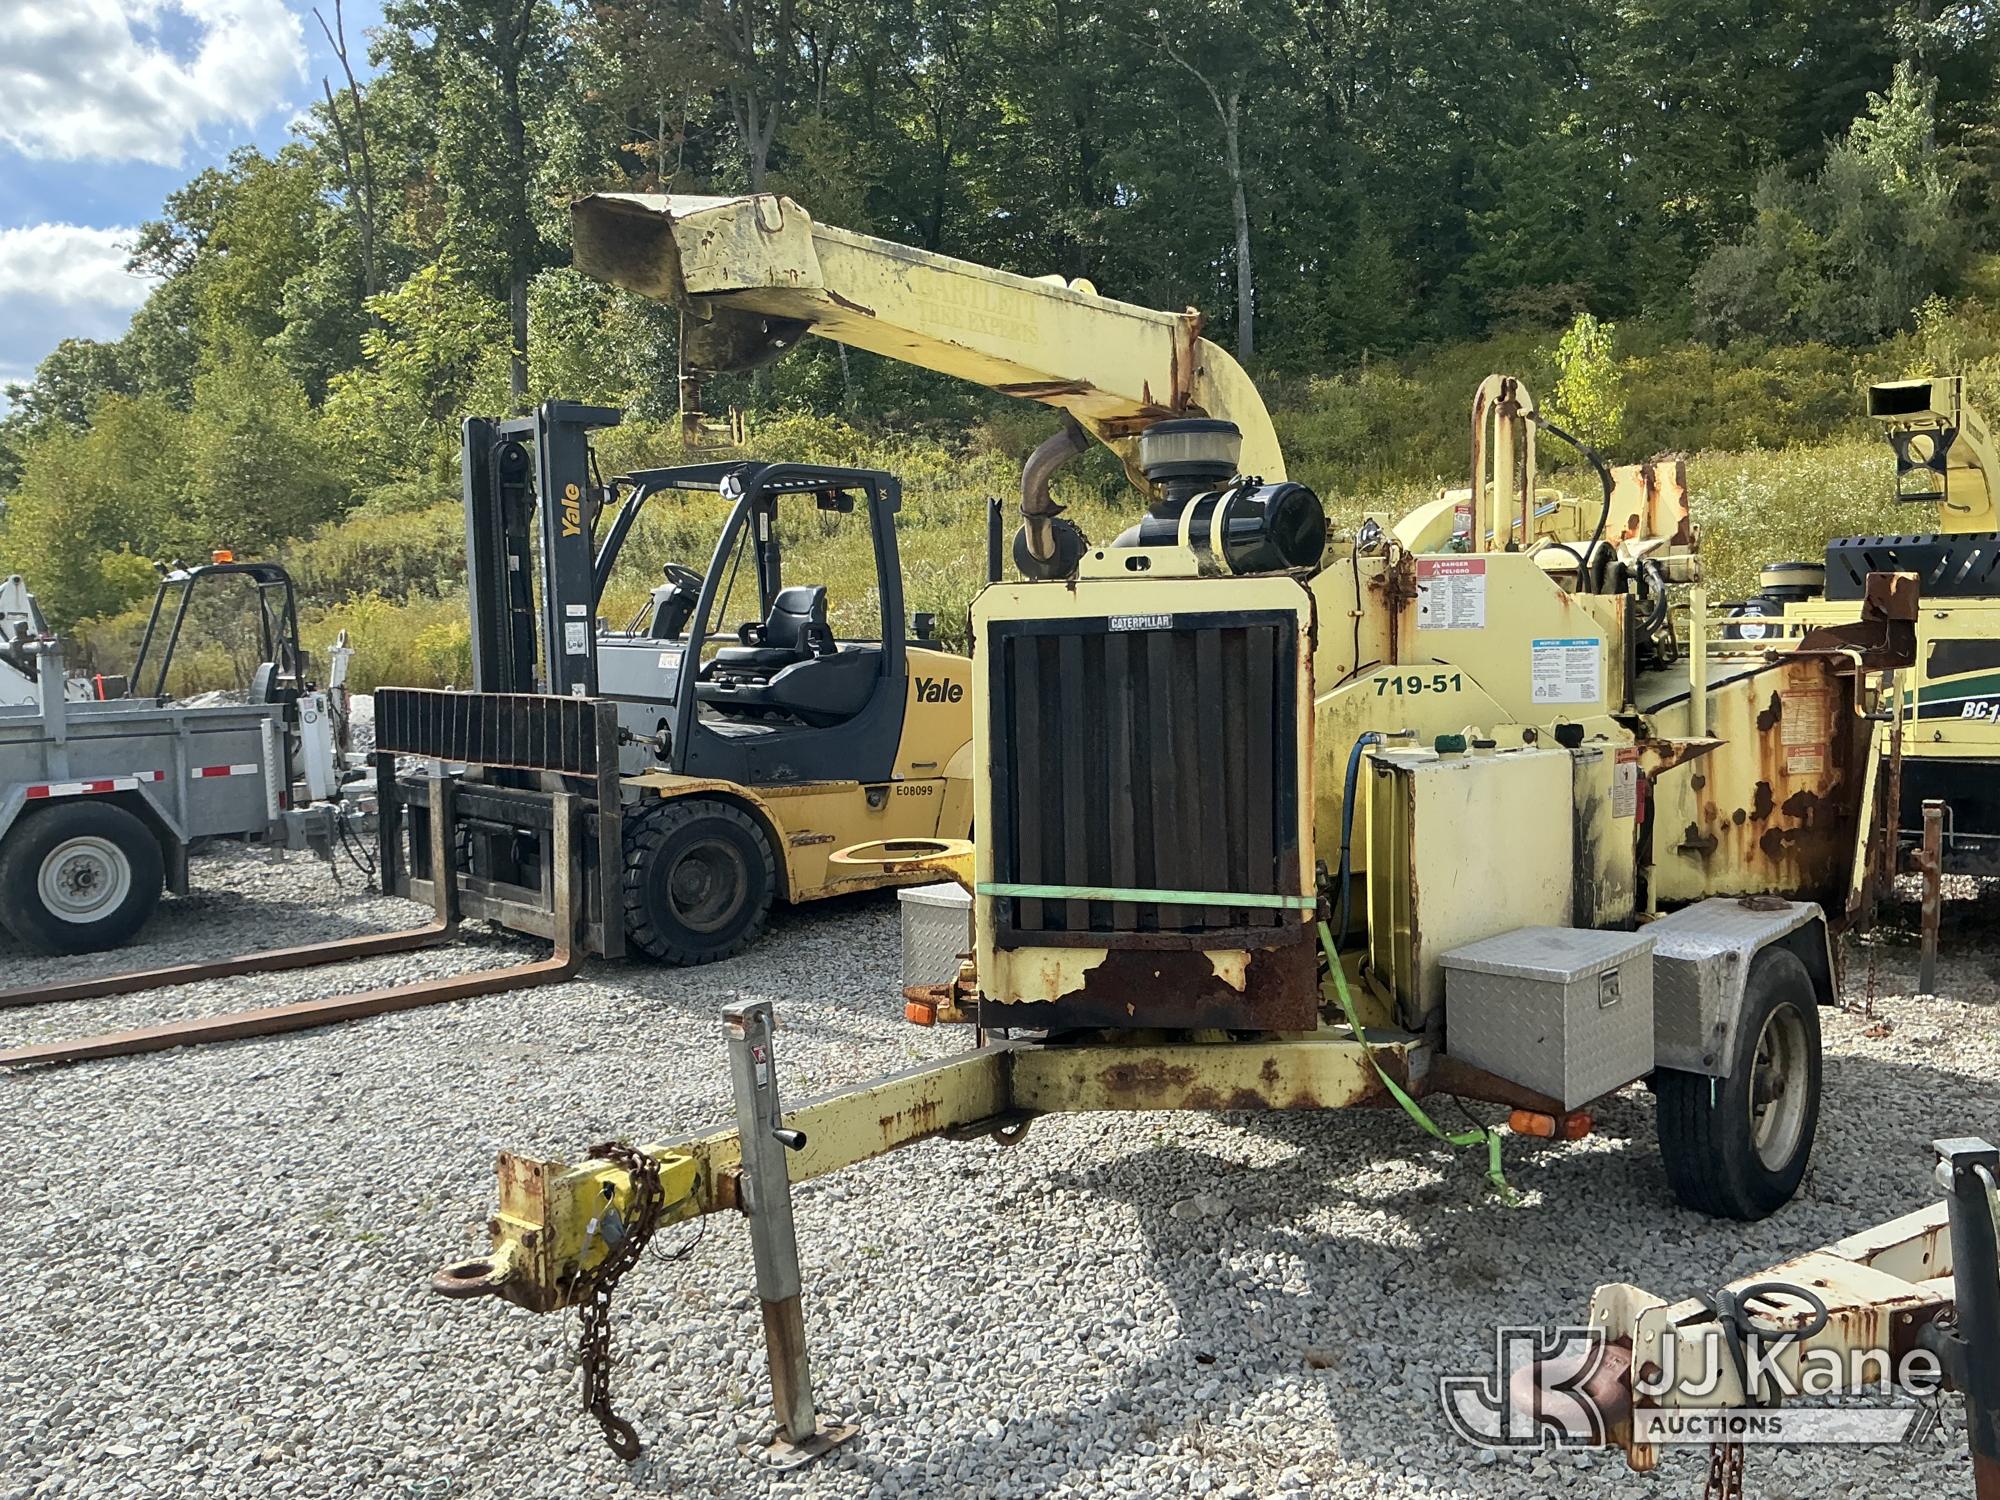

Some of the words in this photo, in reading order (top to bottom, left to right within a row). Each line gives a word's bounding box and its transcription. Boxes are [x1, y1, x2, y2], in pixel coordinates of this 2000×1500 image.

[561, 483, 582, 538] Yale
[1111, 615, 1169, 629] CATERPILLAR
[914, 677, 964, 703] Yale
[1373, 673, 1462, 696] 719-51
[896, 785, 933, 796] E08099
